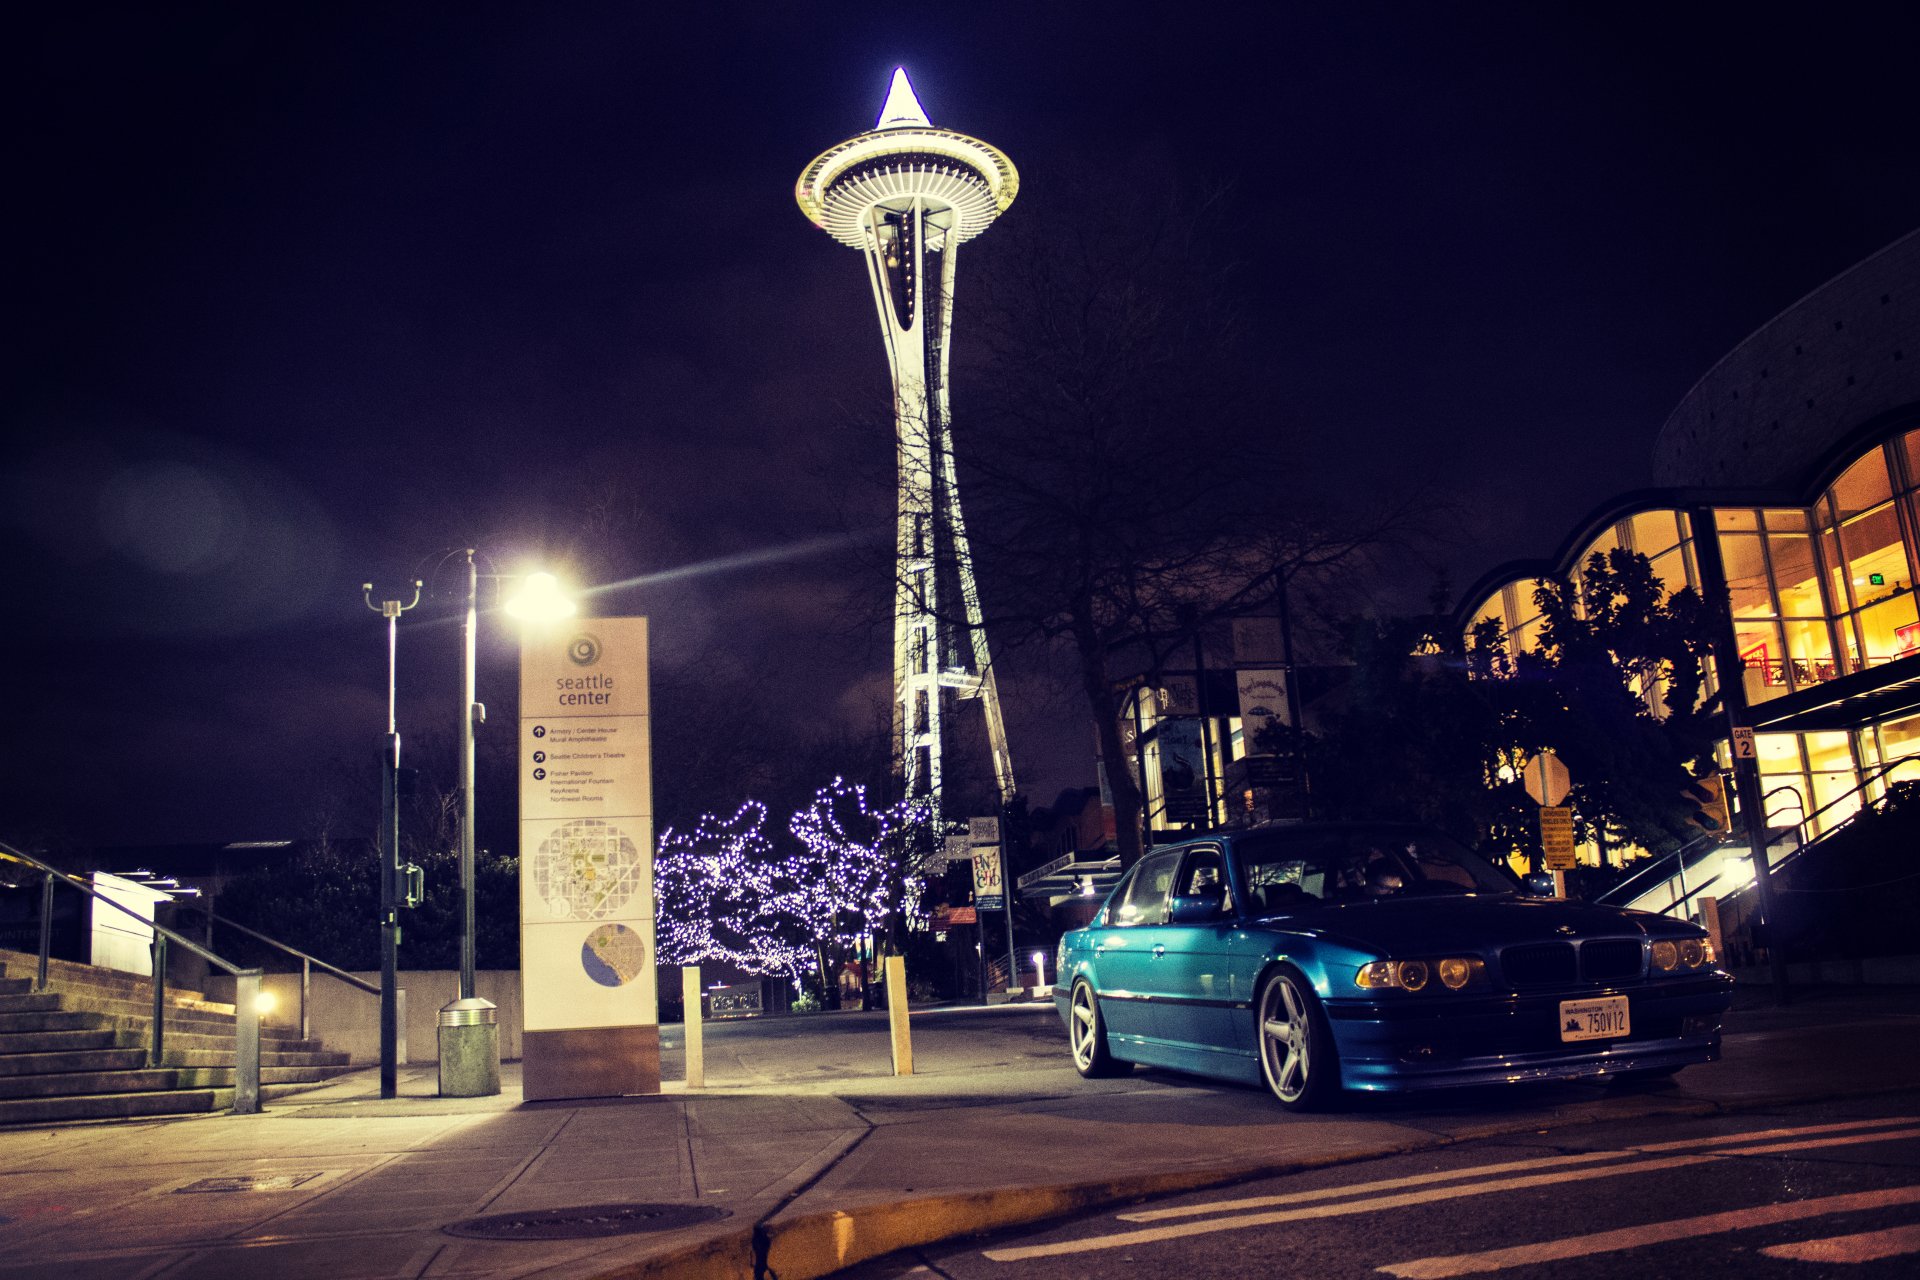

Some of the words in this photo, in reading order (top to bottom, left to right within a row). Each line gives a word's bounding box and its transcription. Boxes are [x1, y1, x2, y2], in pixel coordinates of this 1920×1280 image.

[556, 674, 613, 690] seattle
[559, 691, 611, 706] center
[1734, 729, 1753, 739] GATE
[1741, 740, 1752, 756] 2
[1565, 1006, 1603, 1015] WASHINGTON
[1587, 1011, 1625, 1034] 750V12
